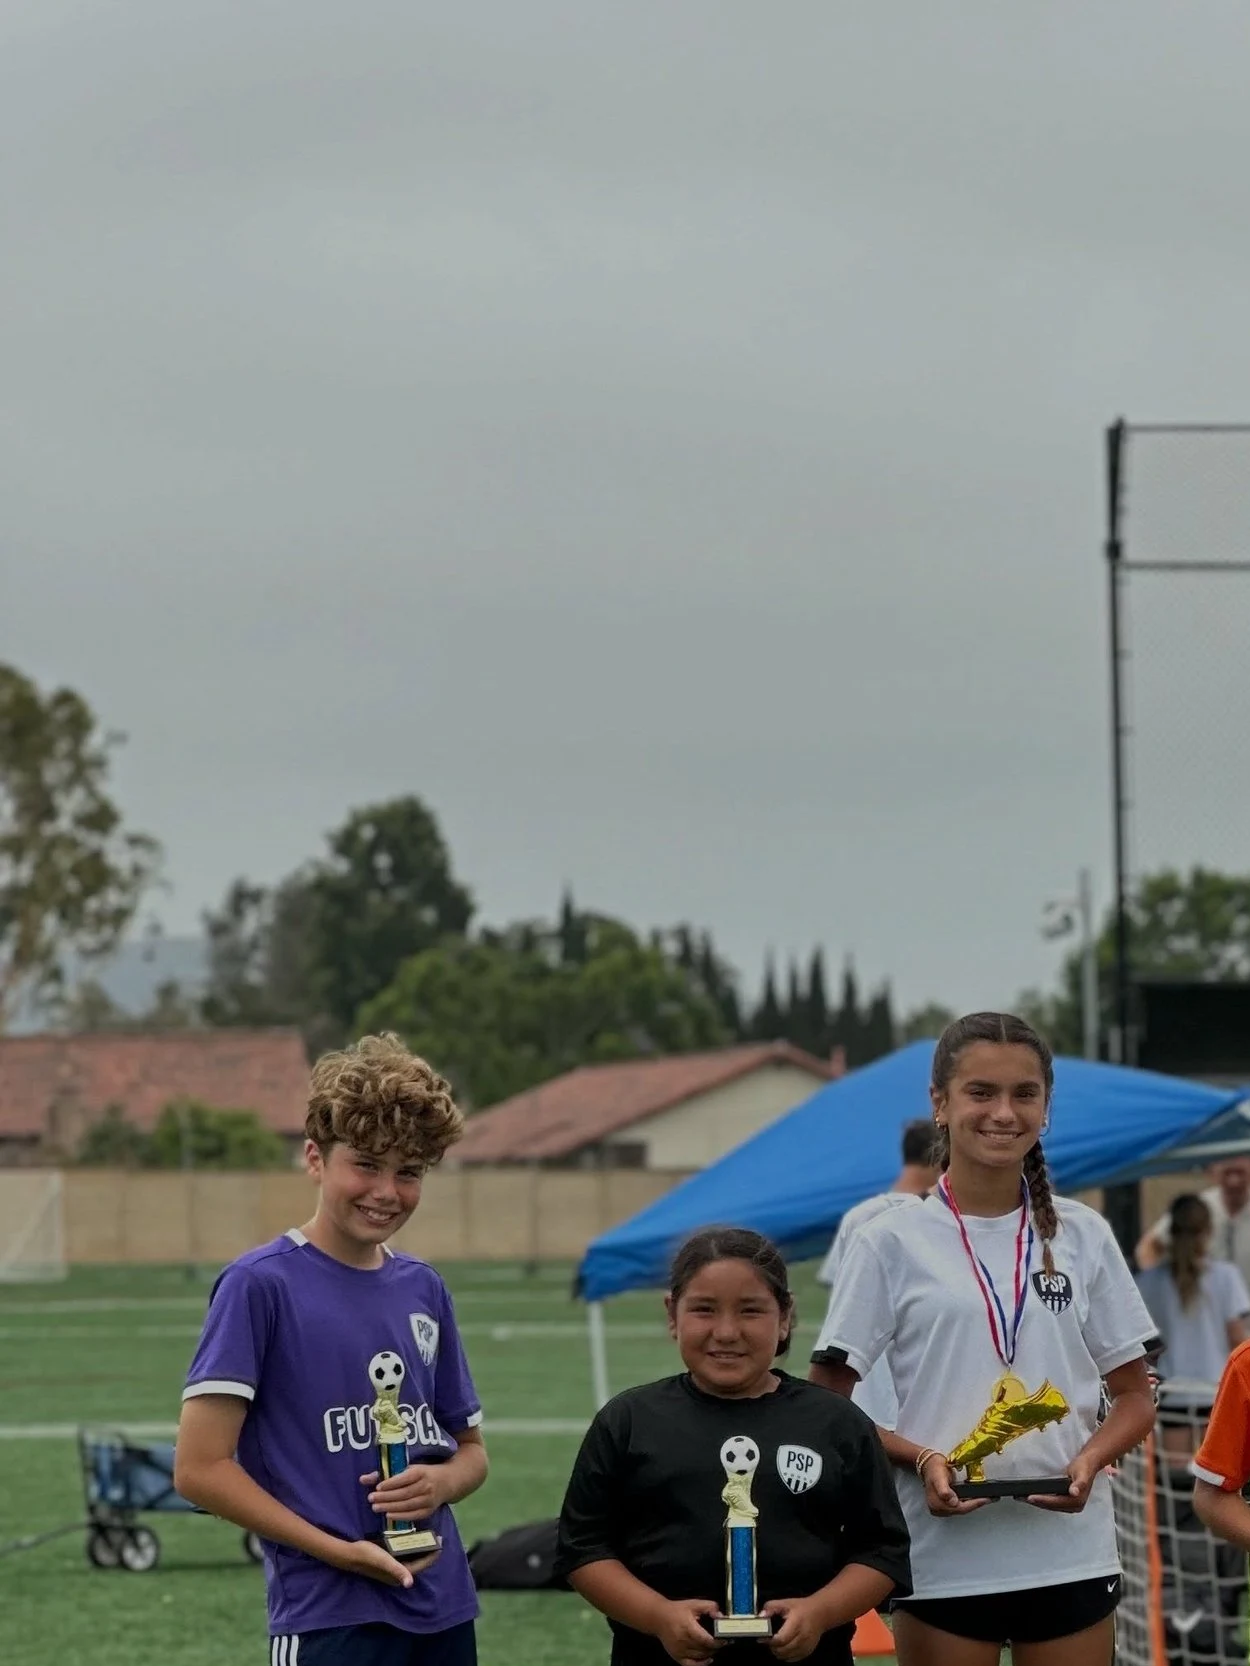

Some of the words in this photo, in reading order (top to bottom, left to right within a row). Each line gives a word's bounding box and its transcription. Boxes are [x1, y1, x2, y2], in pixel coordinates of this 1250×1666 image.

[1038, 1273, 1067, 1294] PSP
[323, 1403, 449, 1453] FUSA
[786, 1450, 814, 1473] PSP
